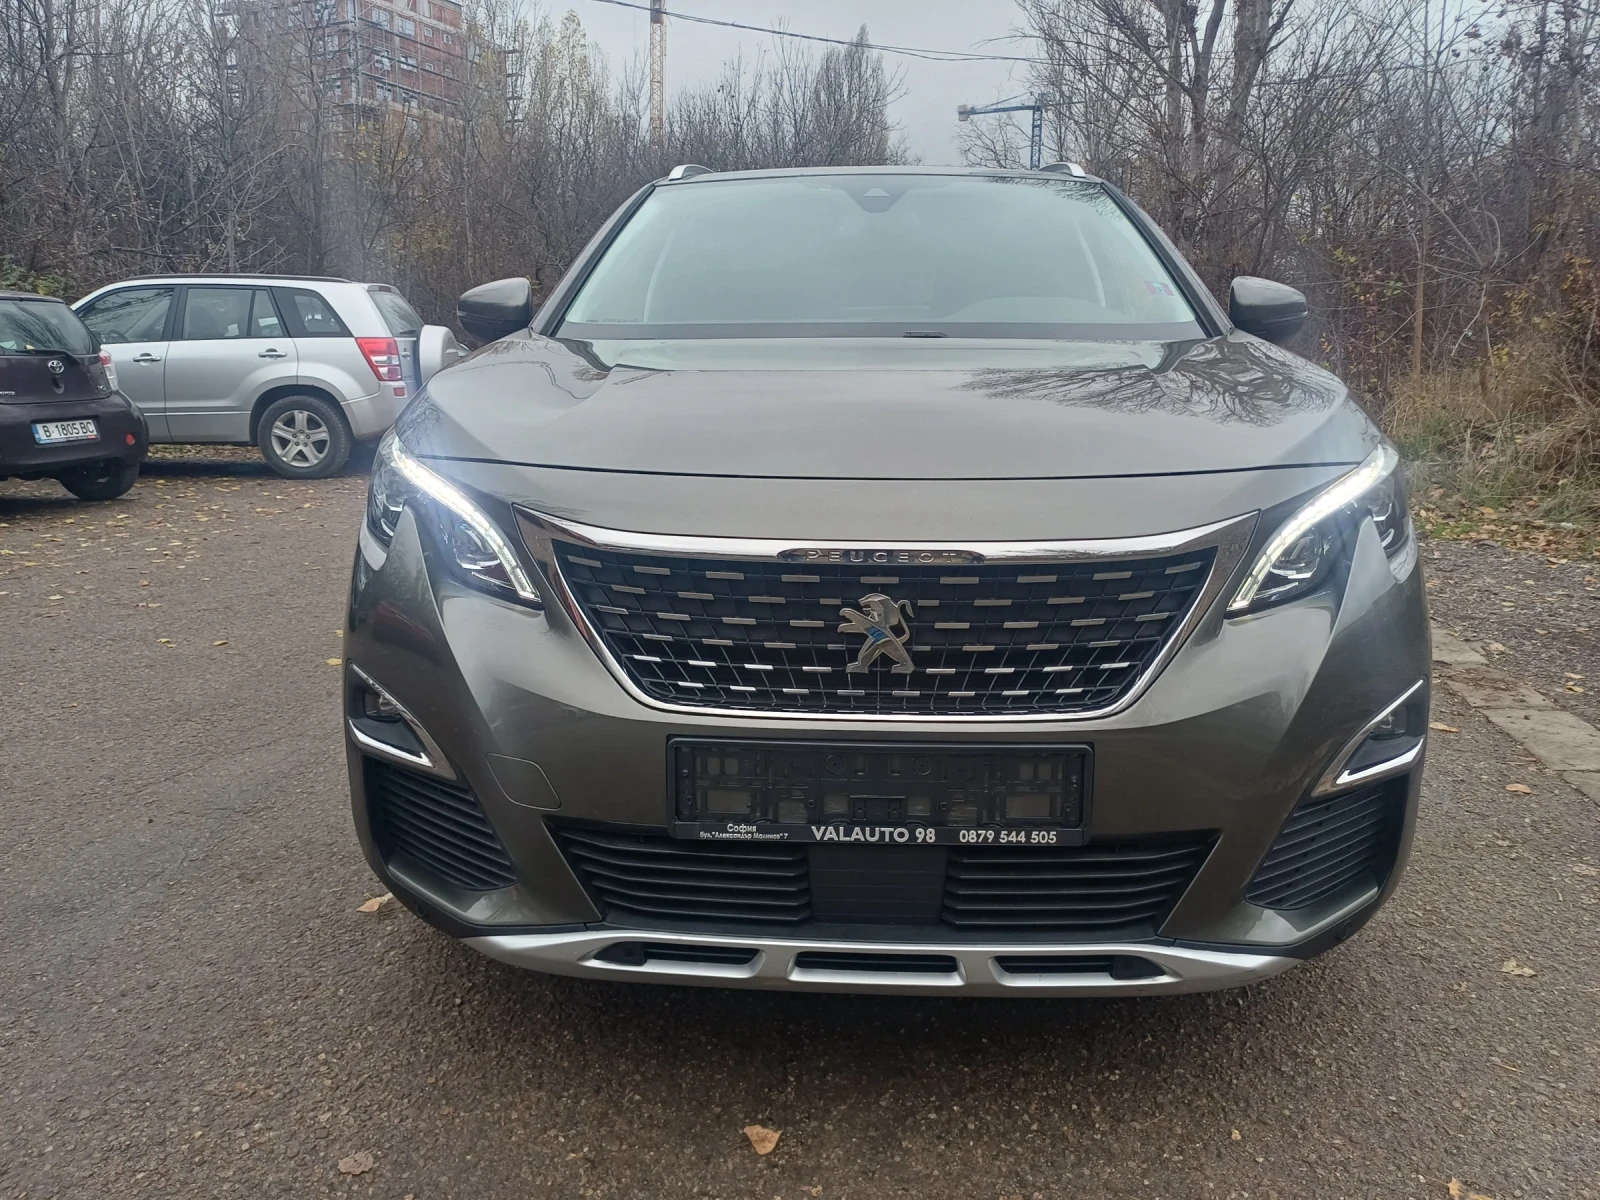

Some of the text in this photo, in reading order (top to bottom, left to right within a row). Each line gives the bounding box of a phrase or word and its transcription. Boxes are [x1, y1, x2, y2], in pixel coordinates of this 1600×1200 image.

[55, 423, 80, 437] 1805
[806, 550, 956, 563] PEUGEOT
[727, 823, 757, 833] София
[811, 826, 936, 843] VALAUTO 98
[959, 830, 1057, 844] 0879 544 505
